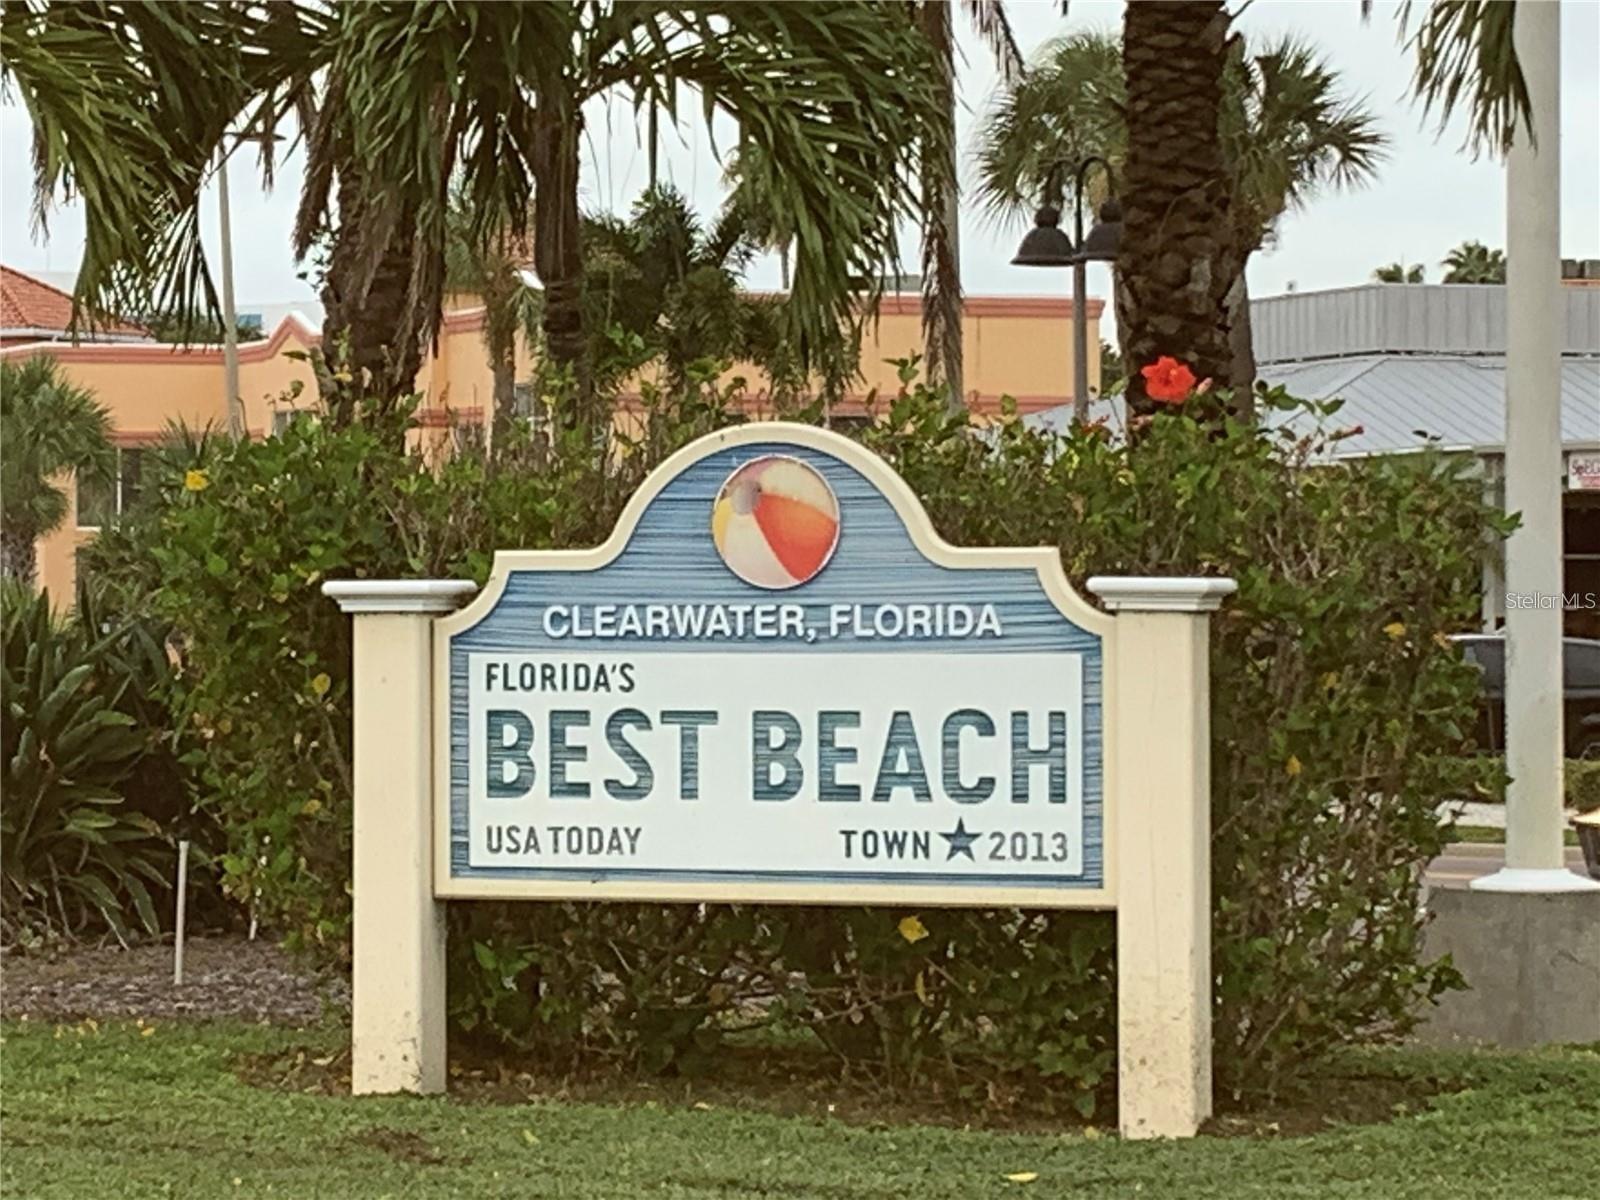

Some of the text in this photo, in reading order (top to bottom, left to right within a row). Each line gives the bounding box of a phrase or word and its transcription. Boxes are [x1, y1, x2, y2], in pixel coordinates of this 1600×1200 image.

[542, 603, 1003, 642] CLEARWATER, FLORIDA
[486, 662, 635, 693] FLORIDA'S
[486, 708, 1067, 805] BEST BEACH
[486, 825, 642, 856] USA TODAY
[839, 829, 1068, 862] TOWN 2013
